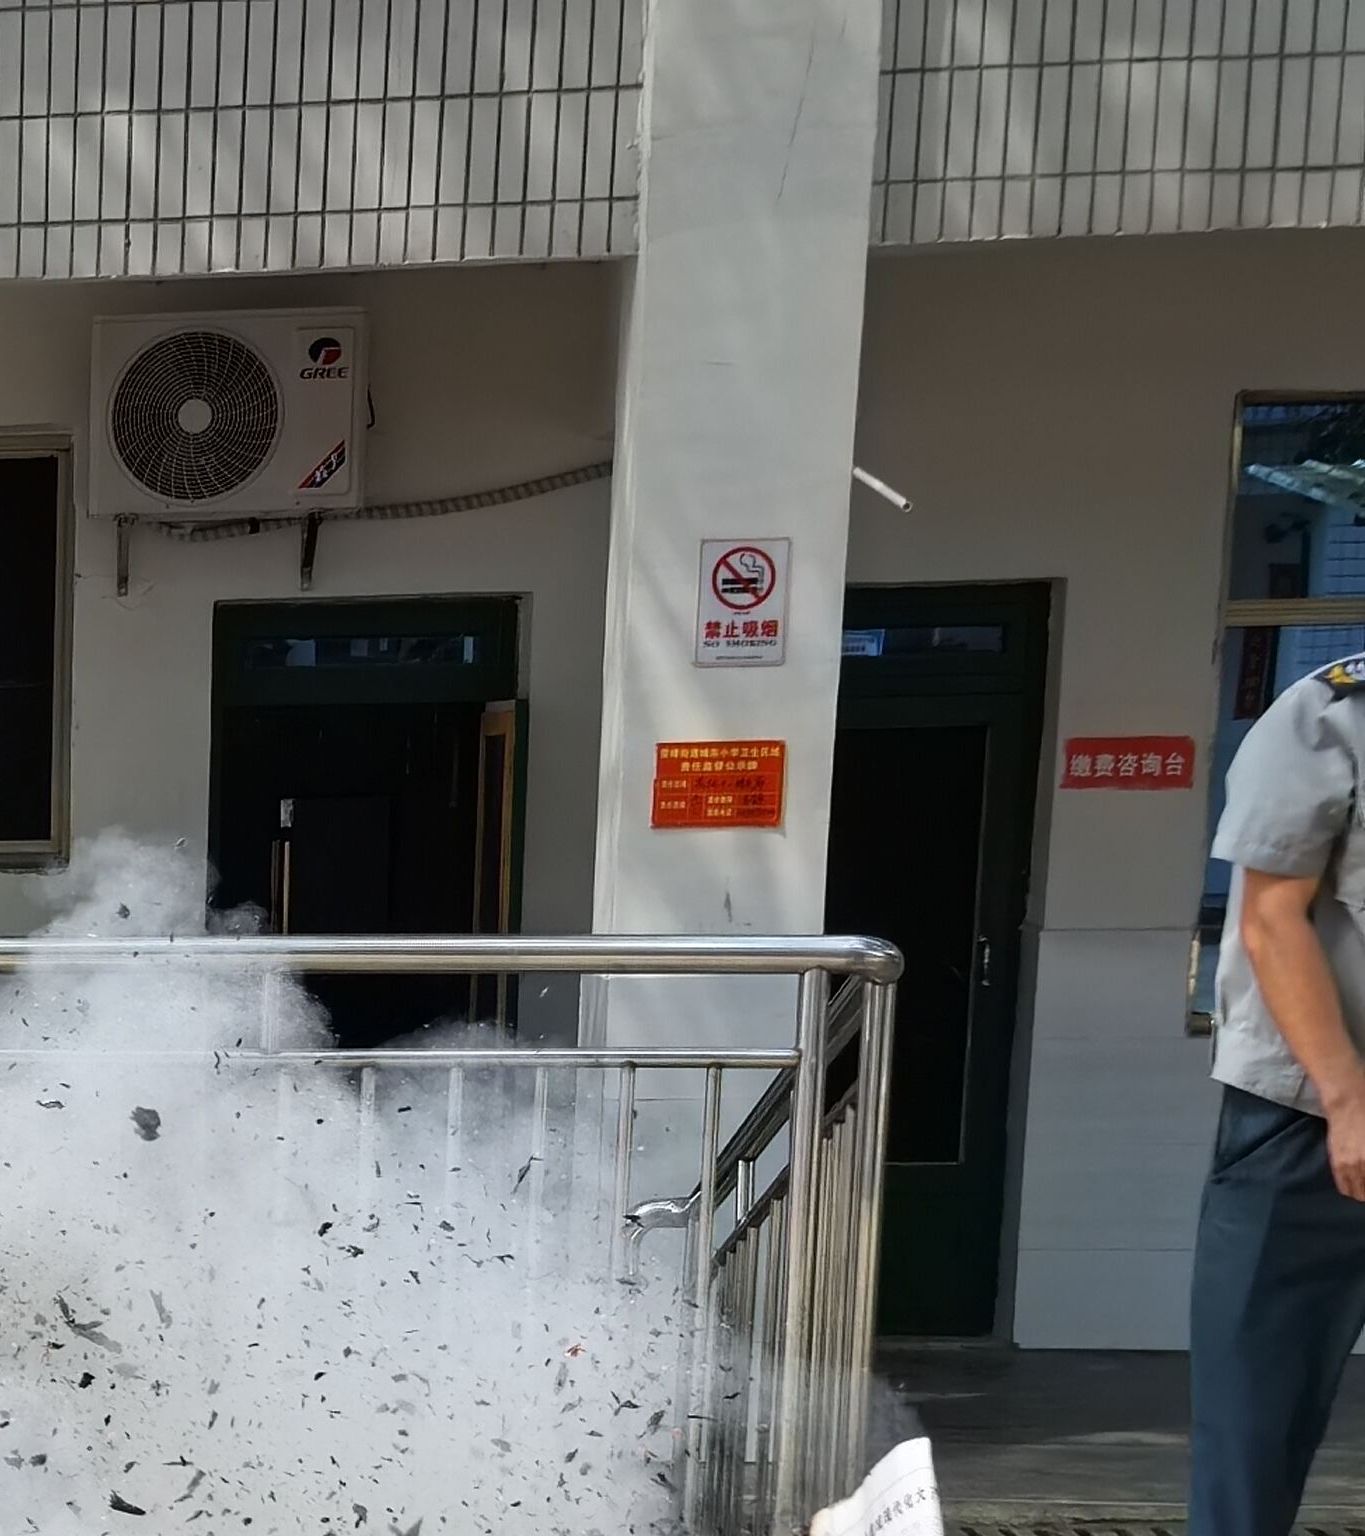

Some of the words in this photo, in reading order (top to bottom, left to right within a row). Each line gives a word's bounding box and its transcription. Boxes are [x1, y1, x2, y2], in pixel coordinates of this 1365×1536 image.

[299, 366, 350, 380] GREE
[705, 620, 779, 639] 禁止吸烟
[1068, 752, 1185, 777] 缴费咨询台
